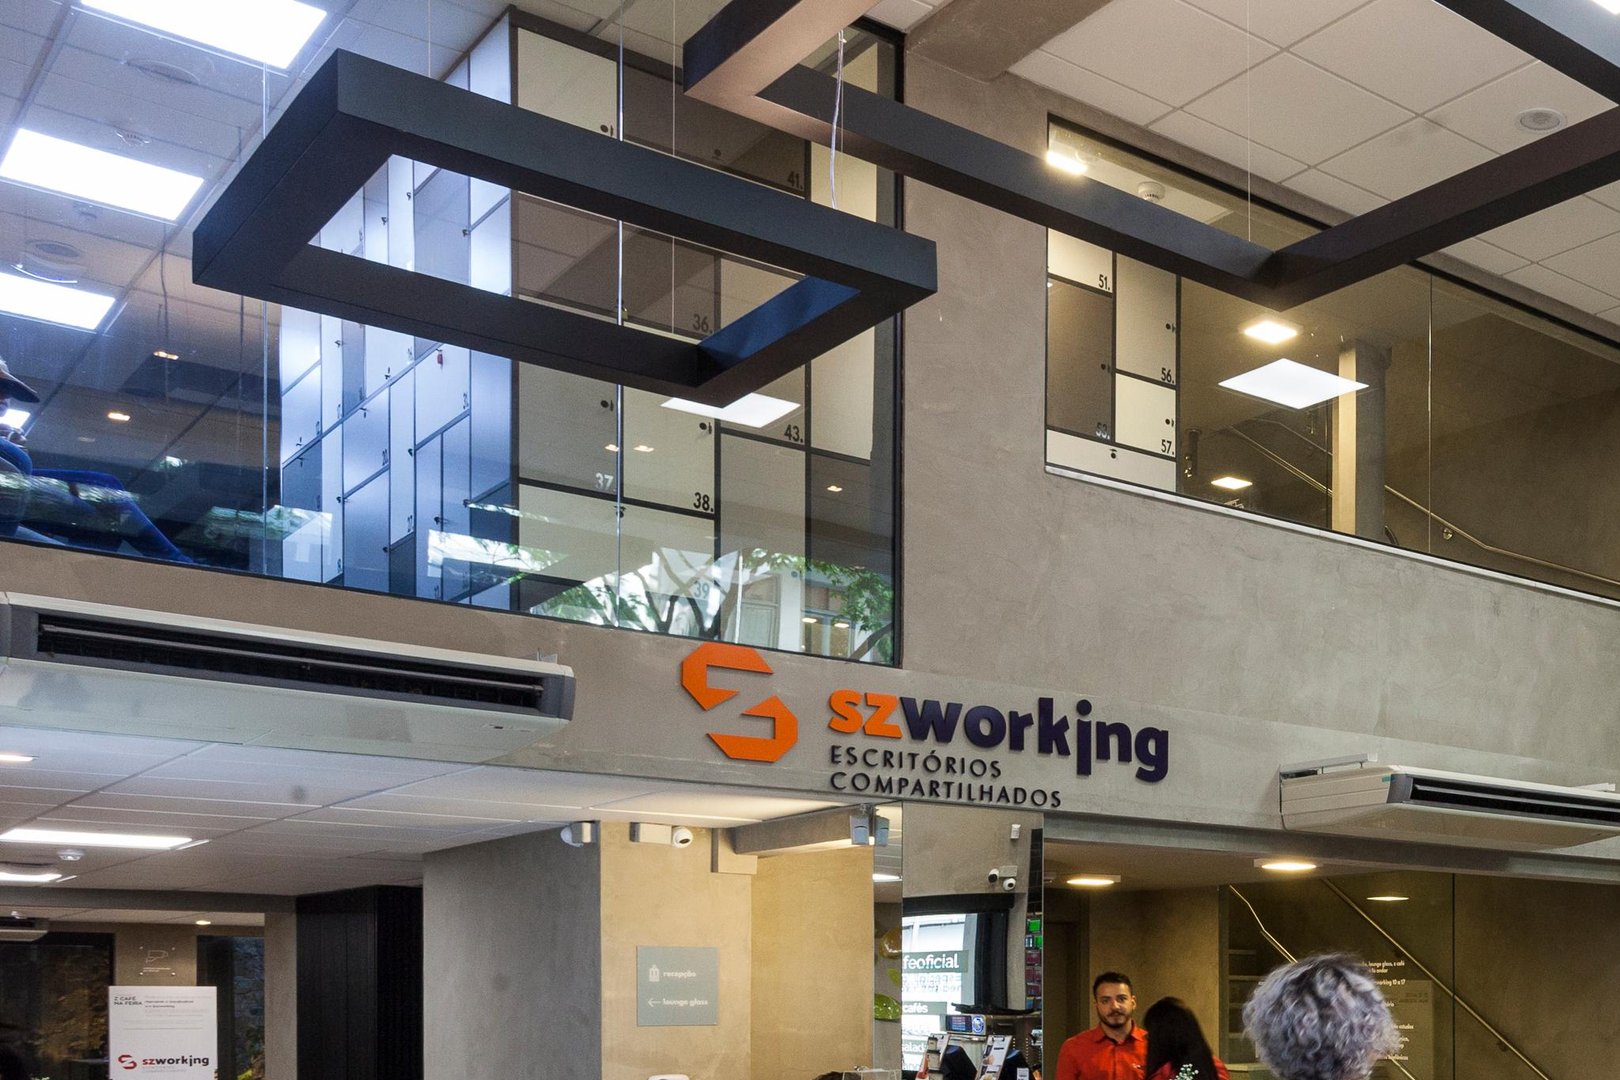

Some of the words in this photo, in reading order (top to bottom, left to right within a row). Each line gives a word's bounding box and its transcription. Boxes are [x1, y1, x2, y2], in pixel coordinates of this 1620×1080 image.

[1098, 274, 1111, 291] 51.
[1161, 367, 1174, 384] 56.
[784, 424, 803, 442] 43.
[1161, 439, 1174, 455] 57.
[693, 492, 714, 512] 38.
[828, 689, 1169, 783] szworking
[830, 745, 1001, 778] ESCRITÓRIOS
[830, 771, 1061, 808] COMPARTILHADOS
